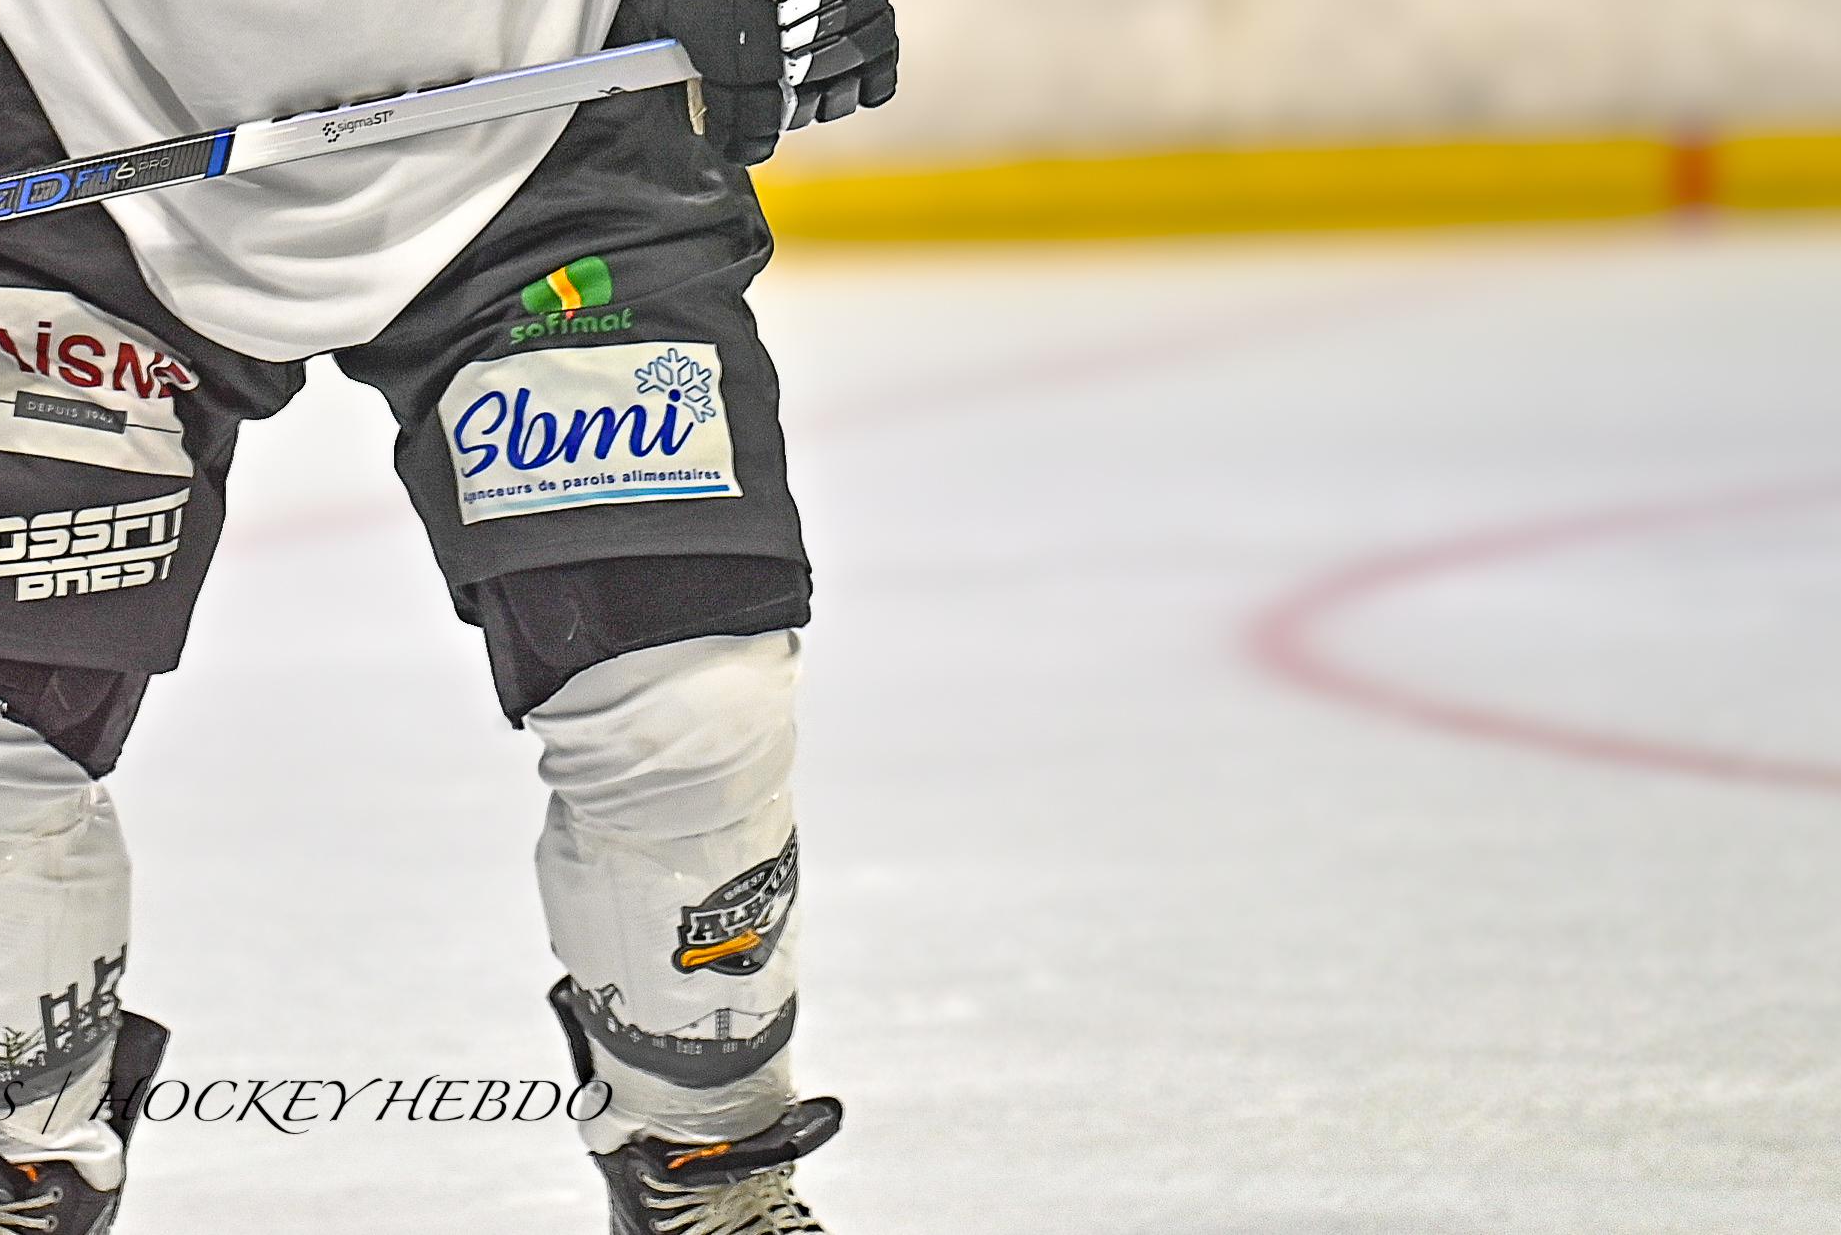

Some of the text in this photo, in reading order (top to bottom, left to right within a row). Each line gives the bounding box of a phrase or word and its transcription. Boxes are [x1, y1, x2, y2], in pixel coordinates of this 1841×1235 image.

[138, 157, 172, 173] PRO
[510, 307, 632, 345] sofimat
[27, 401, 79, 418] DEPUIS
[453, 387, 694, 478] Sbmi
[538, 479, 557, 492] de
[563, 472, 616, 491] parois
[622, 469, 721, 483] alimentaires
